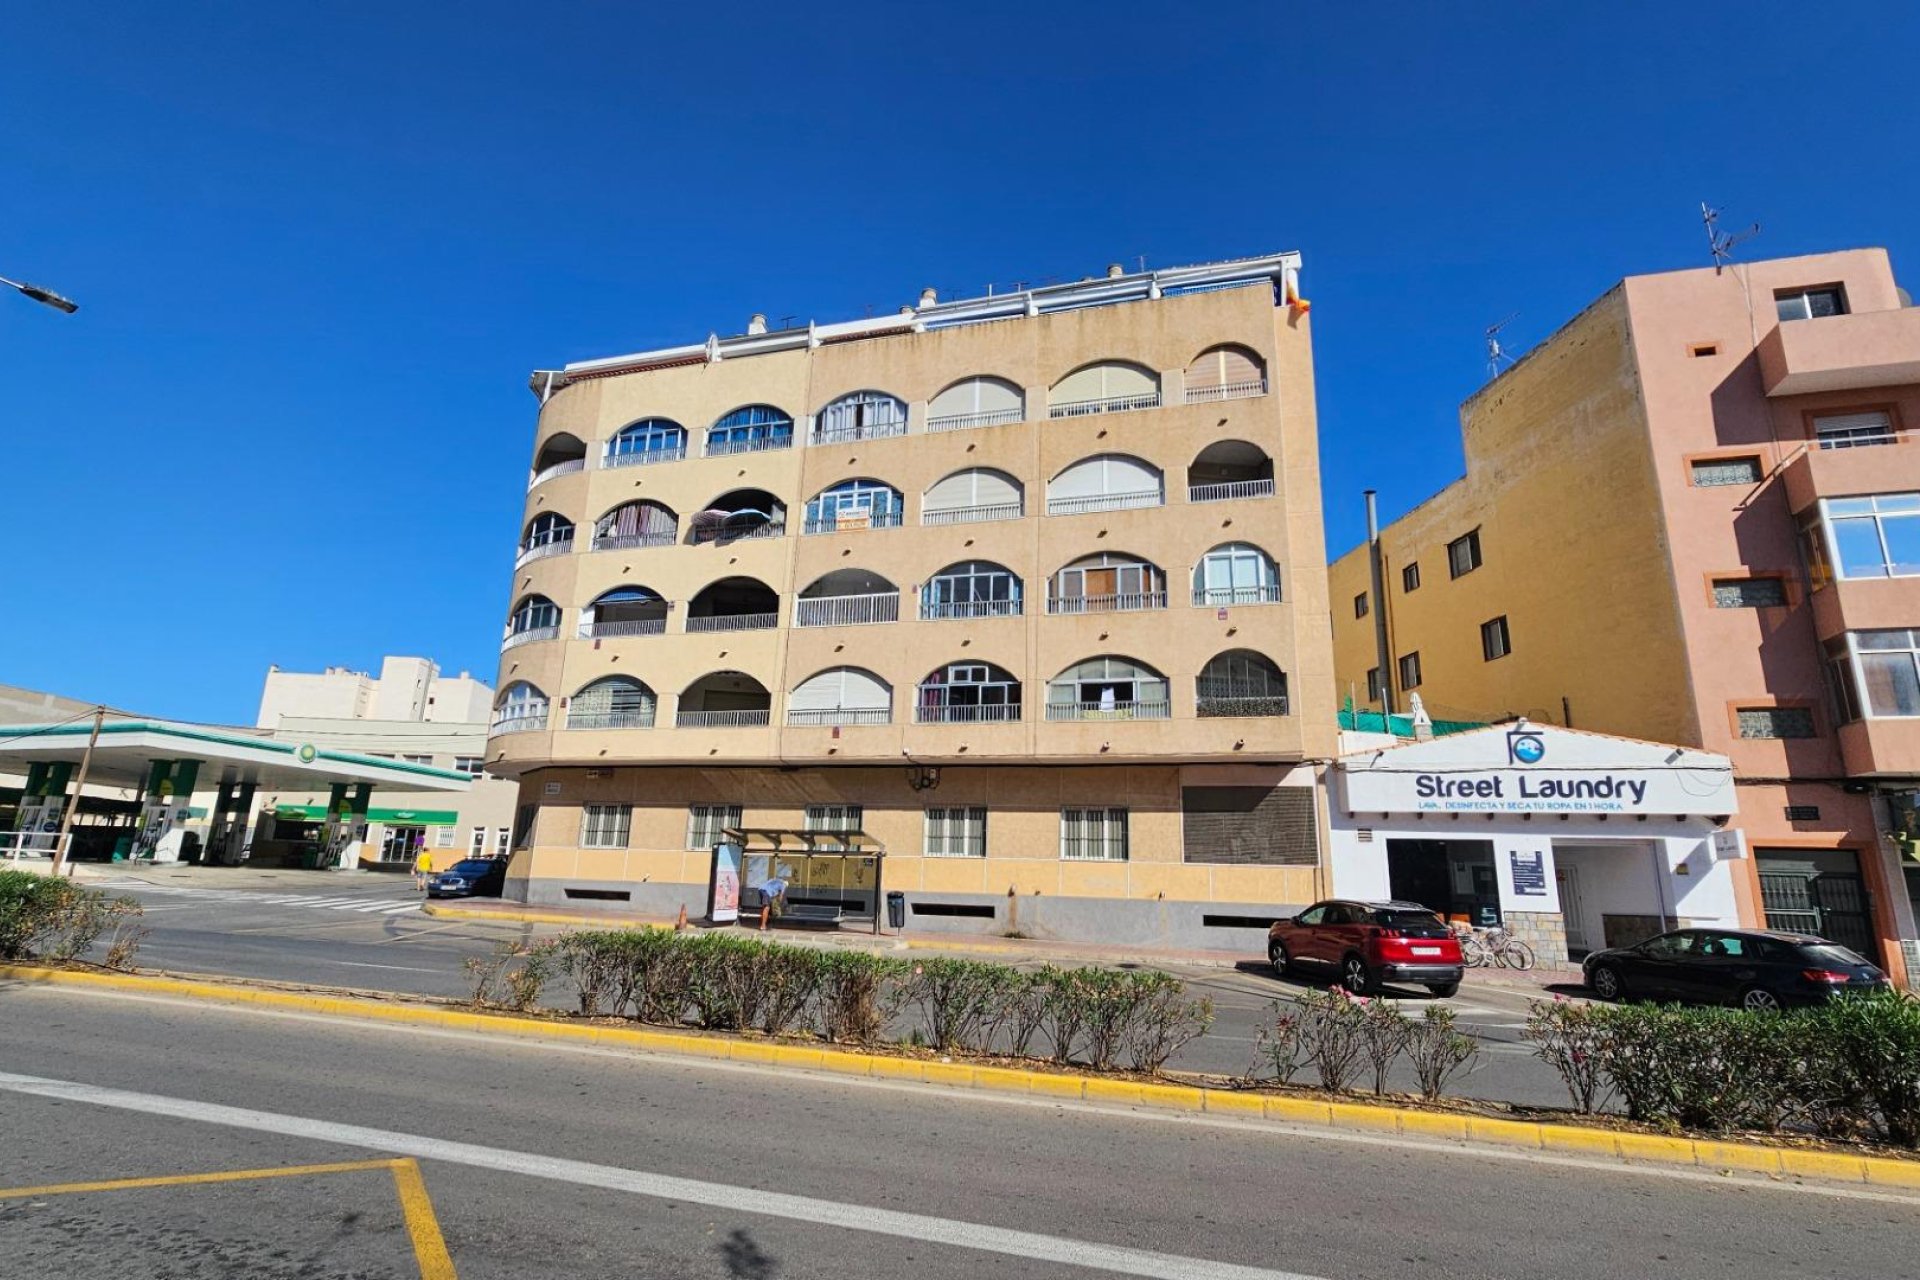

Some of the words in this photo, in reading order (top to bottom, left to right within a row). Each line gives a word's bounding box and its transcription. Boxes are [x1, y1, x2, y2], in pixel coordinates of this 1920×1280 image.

[1416, 775, 1504, 798] Street
[1518, 775, 1647, 805] Laundry
[1445, 802, 1498, 810] DESINFECTA
[1498, 802, 1506, 810] Y
[1507, 802, 1533, 810] SECA
[1533, 802, 1545, 810] TU
[1547, 802, 1571, 810] ROPA
[1574, 802, 1587, 810] EN
[1593, 802, 1623, 811] HORA
